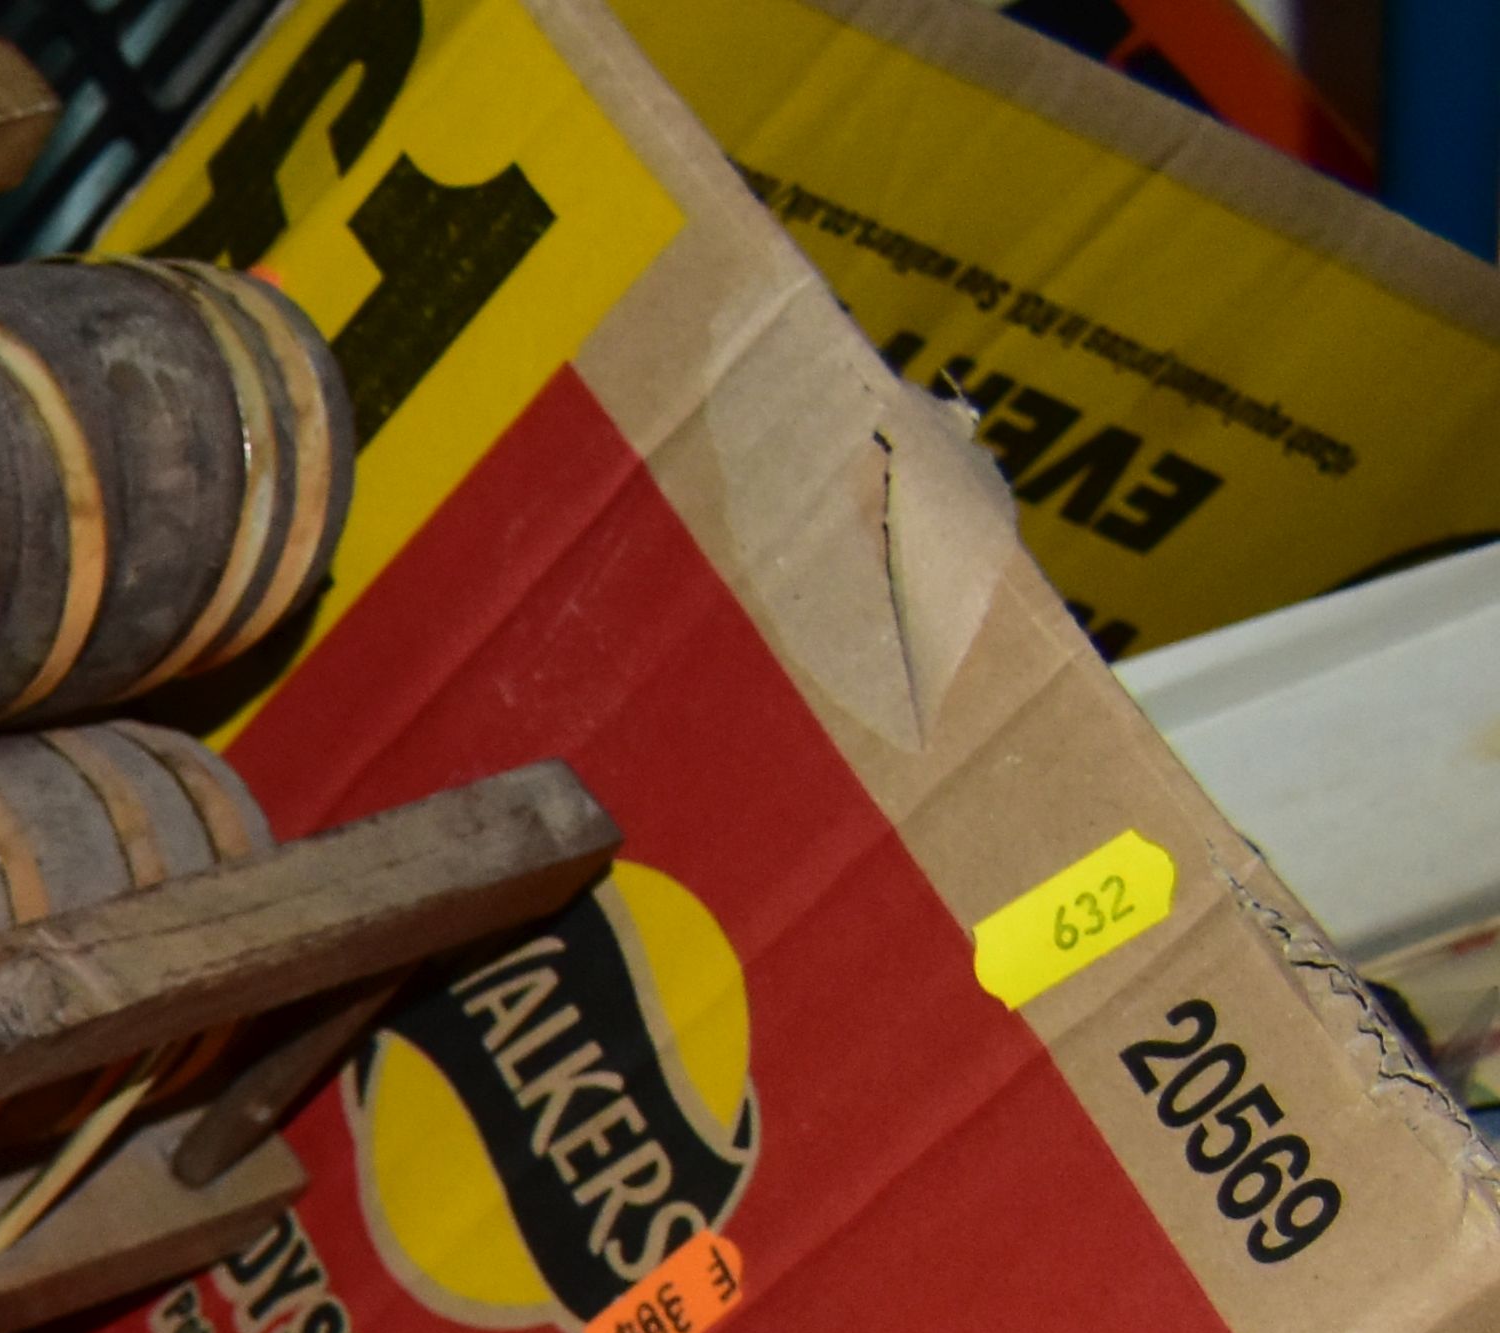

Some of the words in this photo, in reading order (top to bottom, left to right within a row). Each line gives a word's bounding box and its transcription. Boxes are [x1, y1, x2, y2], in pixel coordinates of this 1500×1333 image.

[1052, 875, 1135, 952] 632
[449, 935, 713, 1285] ALKERS
[1119, 998, 1342, 1264] 20569
